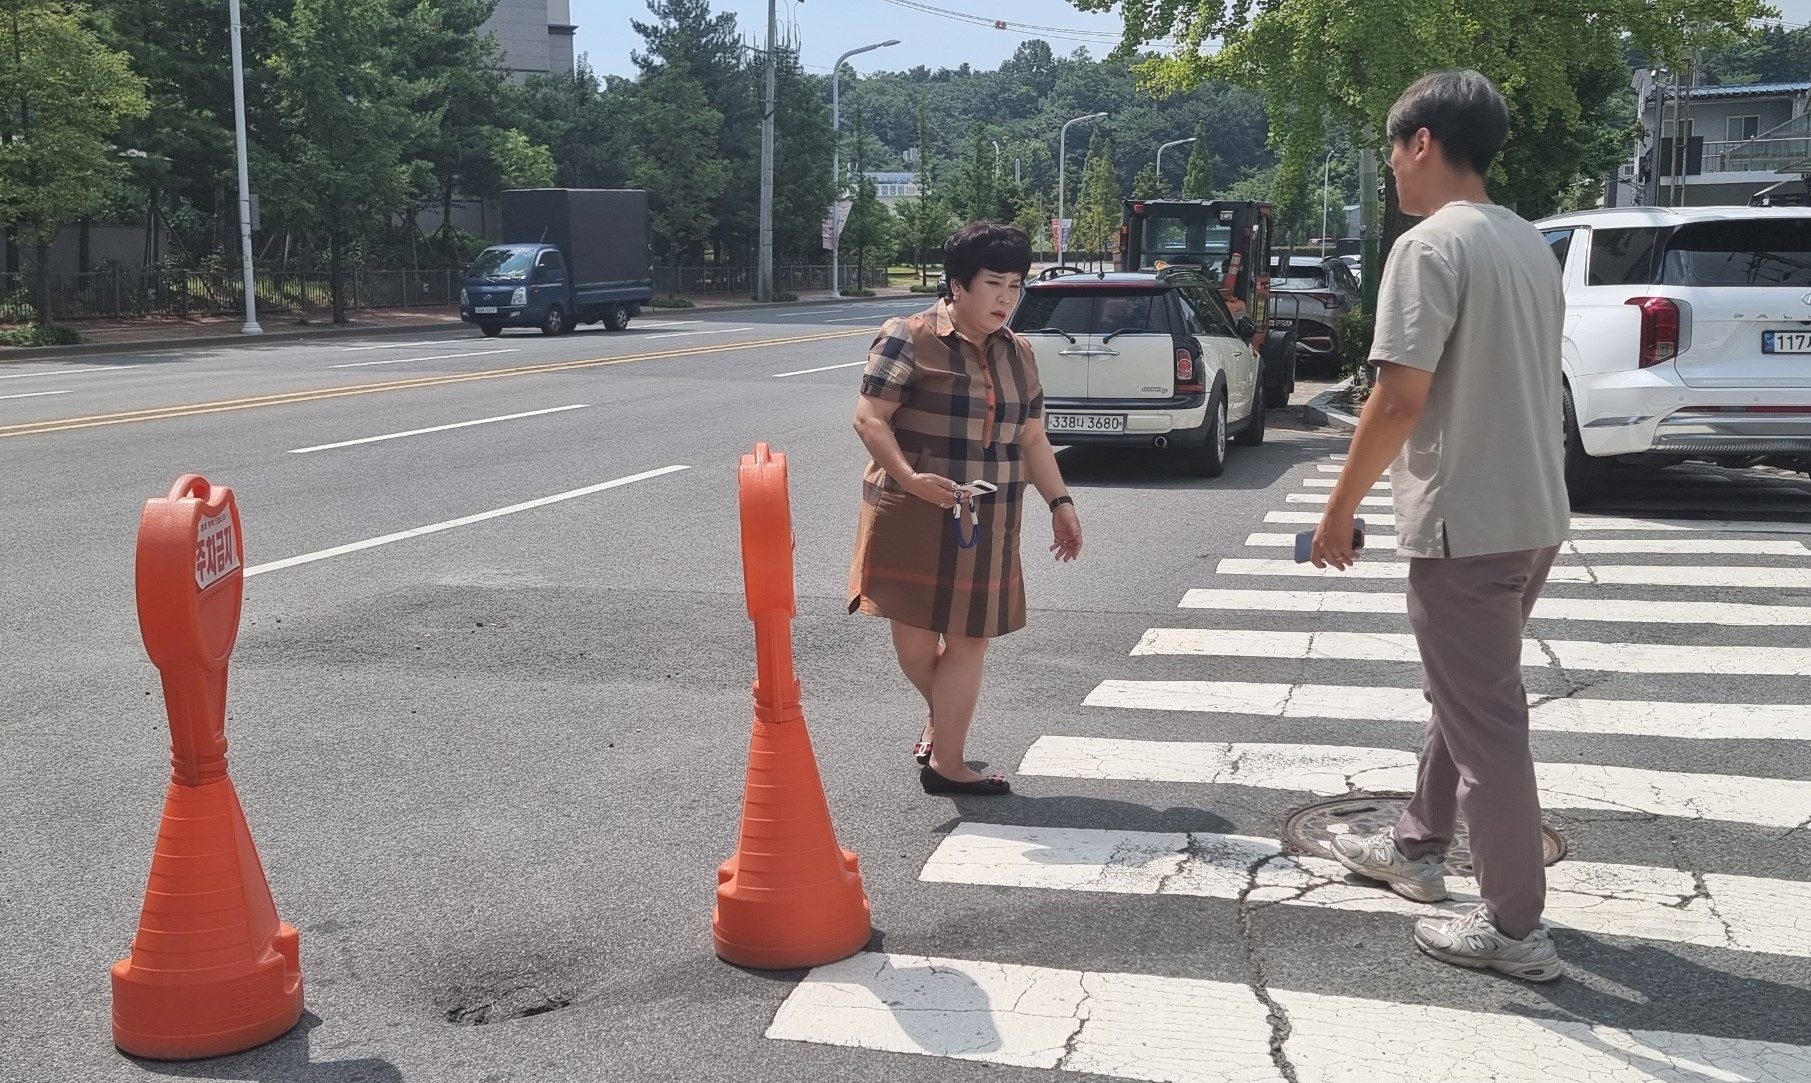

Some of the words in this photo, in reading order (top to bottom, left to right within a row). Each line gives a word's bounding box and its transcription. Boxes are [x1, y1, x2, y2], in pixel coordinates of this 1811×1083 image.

[1052, 416, 1084, 429] 338나
[1087, 417, 1119, 430] 3680
[197, 525, 233, 582] 주차금지
[1374, 848, 1387, 861] N
[1465, 934, 1487, 951] N
